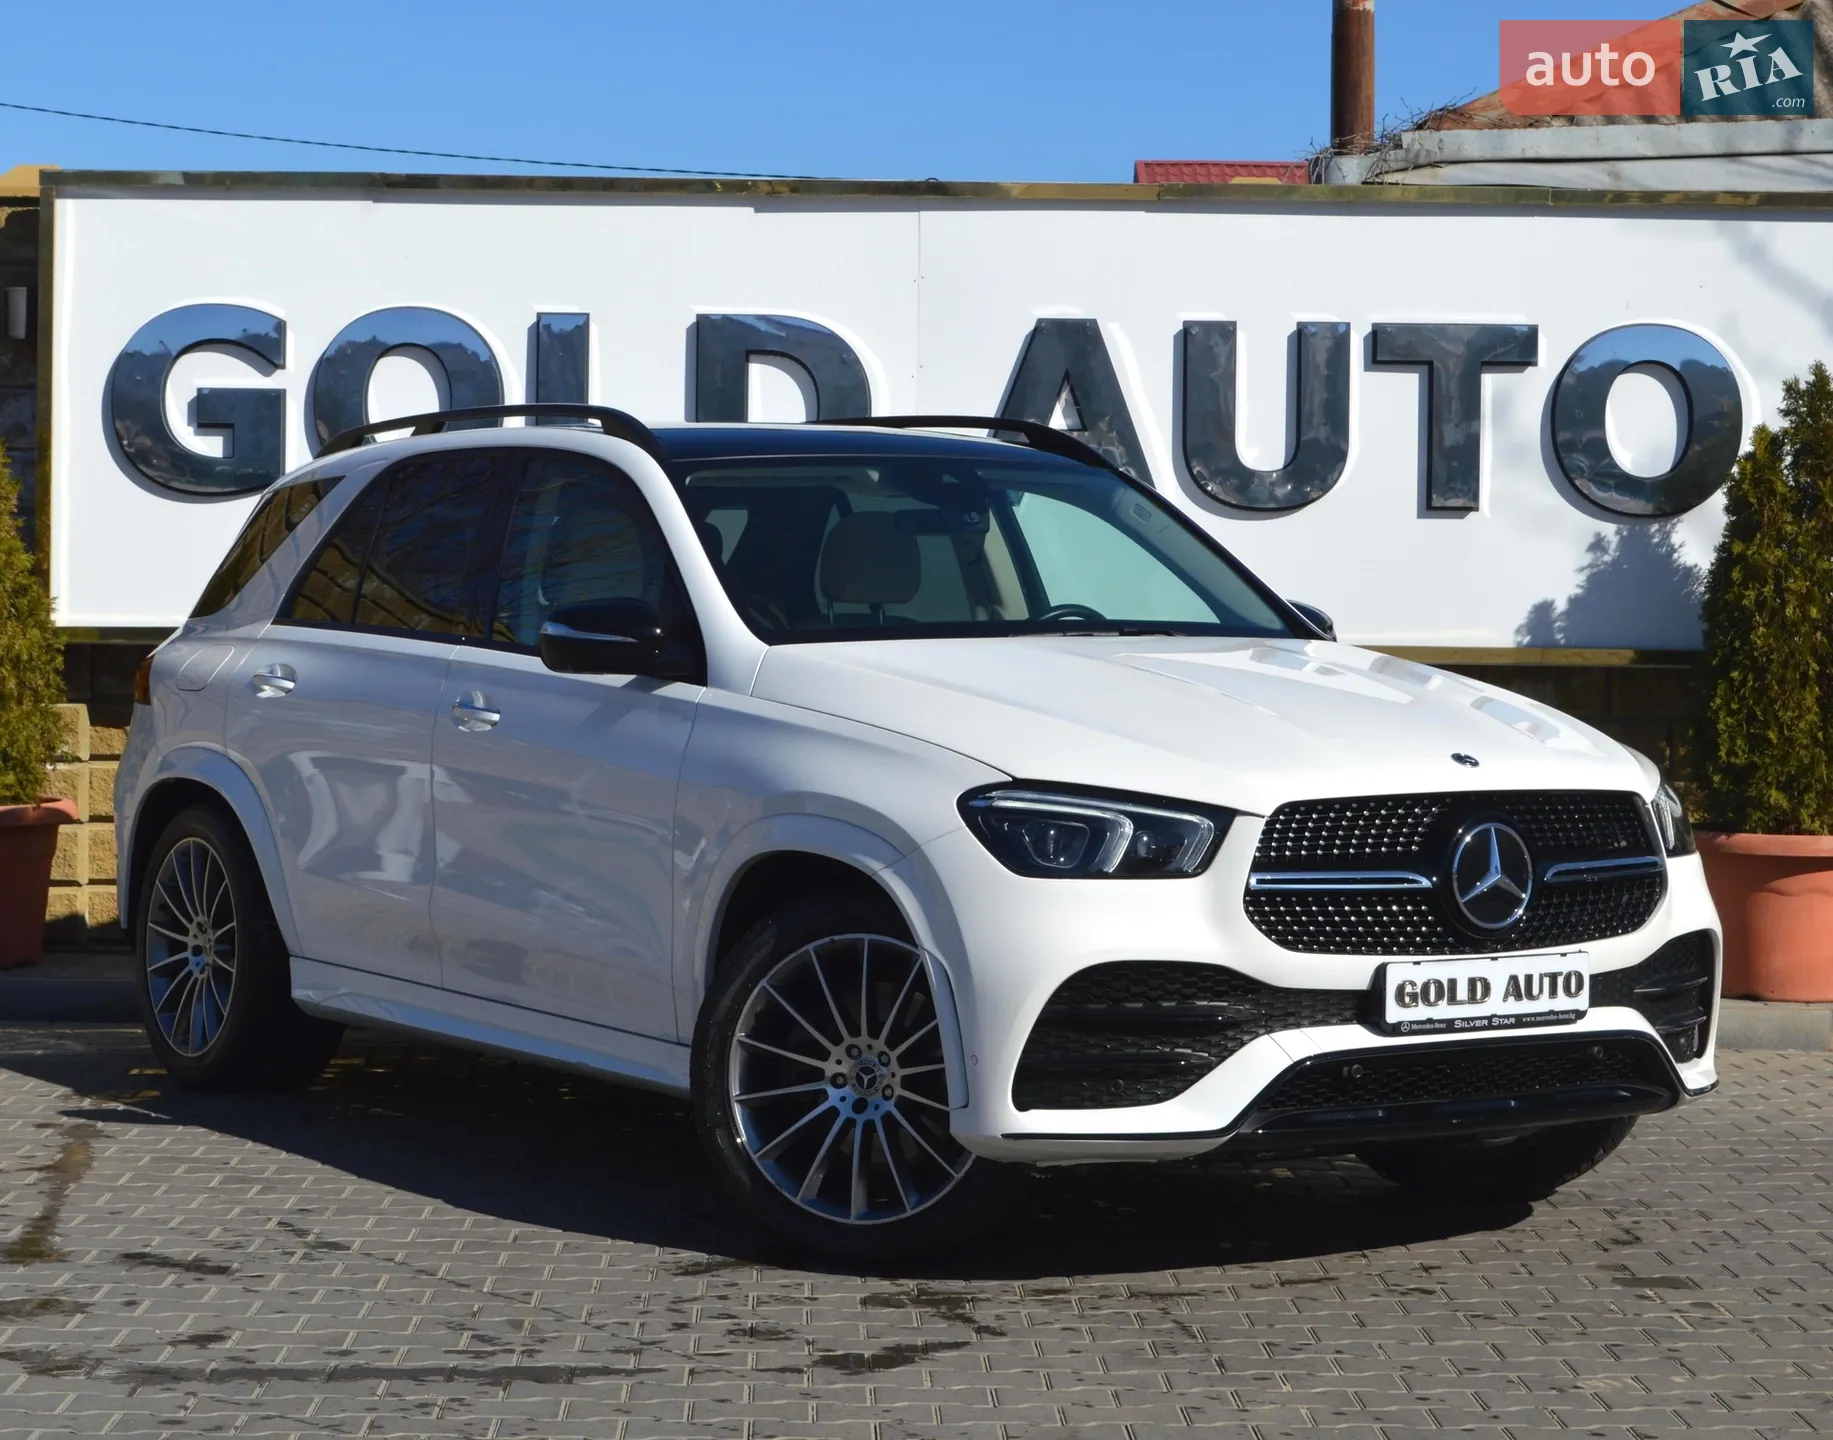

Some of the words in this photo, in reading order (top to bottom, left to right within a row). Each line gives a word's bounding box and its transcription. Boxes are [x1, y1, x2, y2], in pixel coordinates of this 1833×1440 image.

[992, 317, 1744, 518] AUTO
[1394, 977, 1491, 1008] GOLD
[1503, 970, 1584, 1002] AUTO
